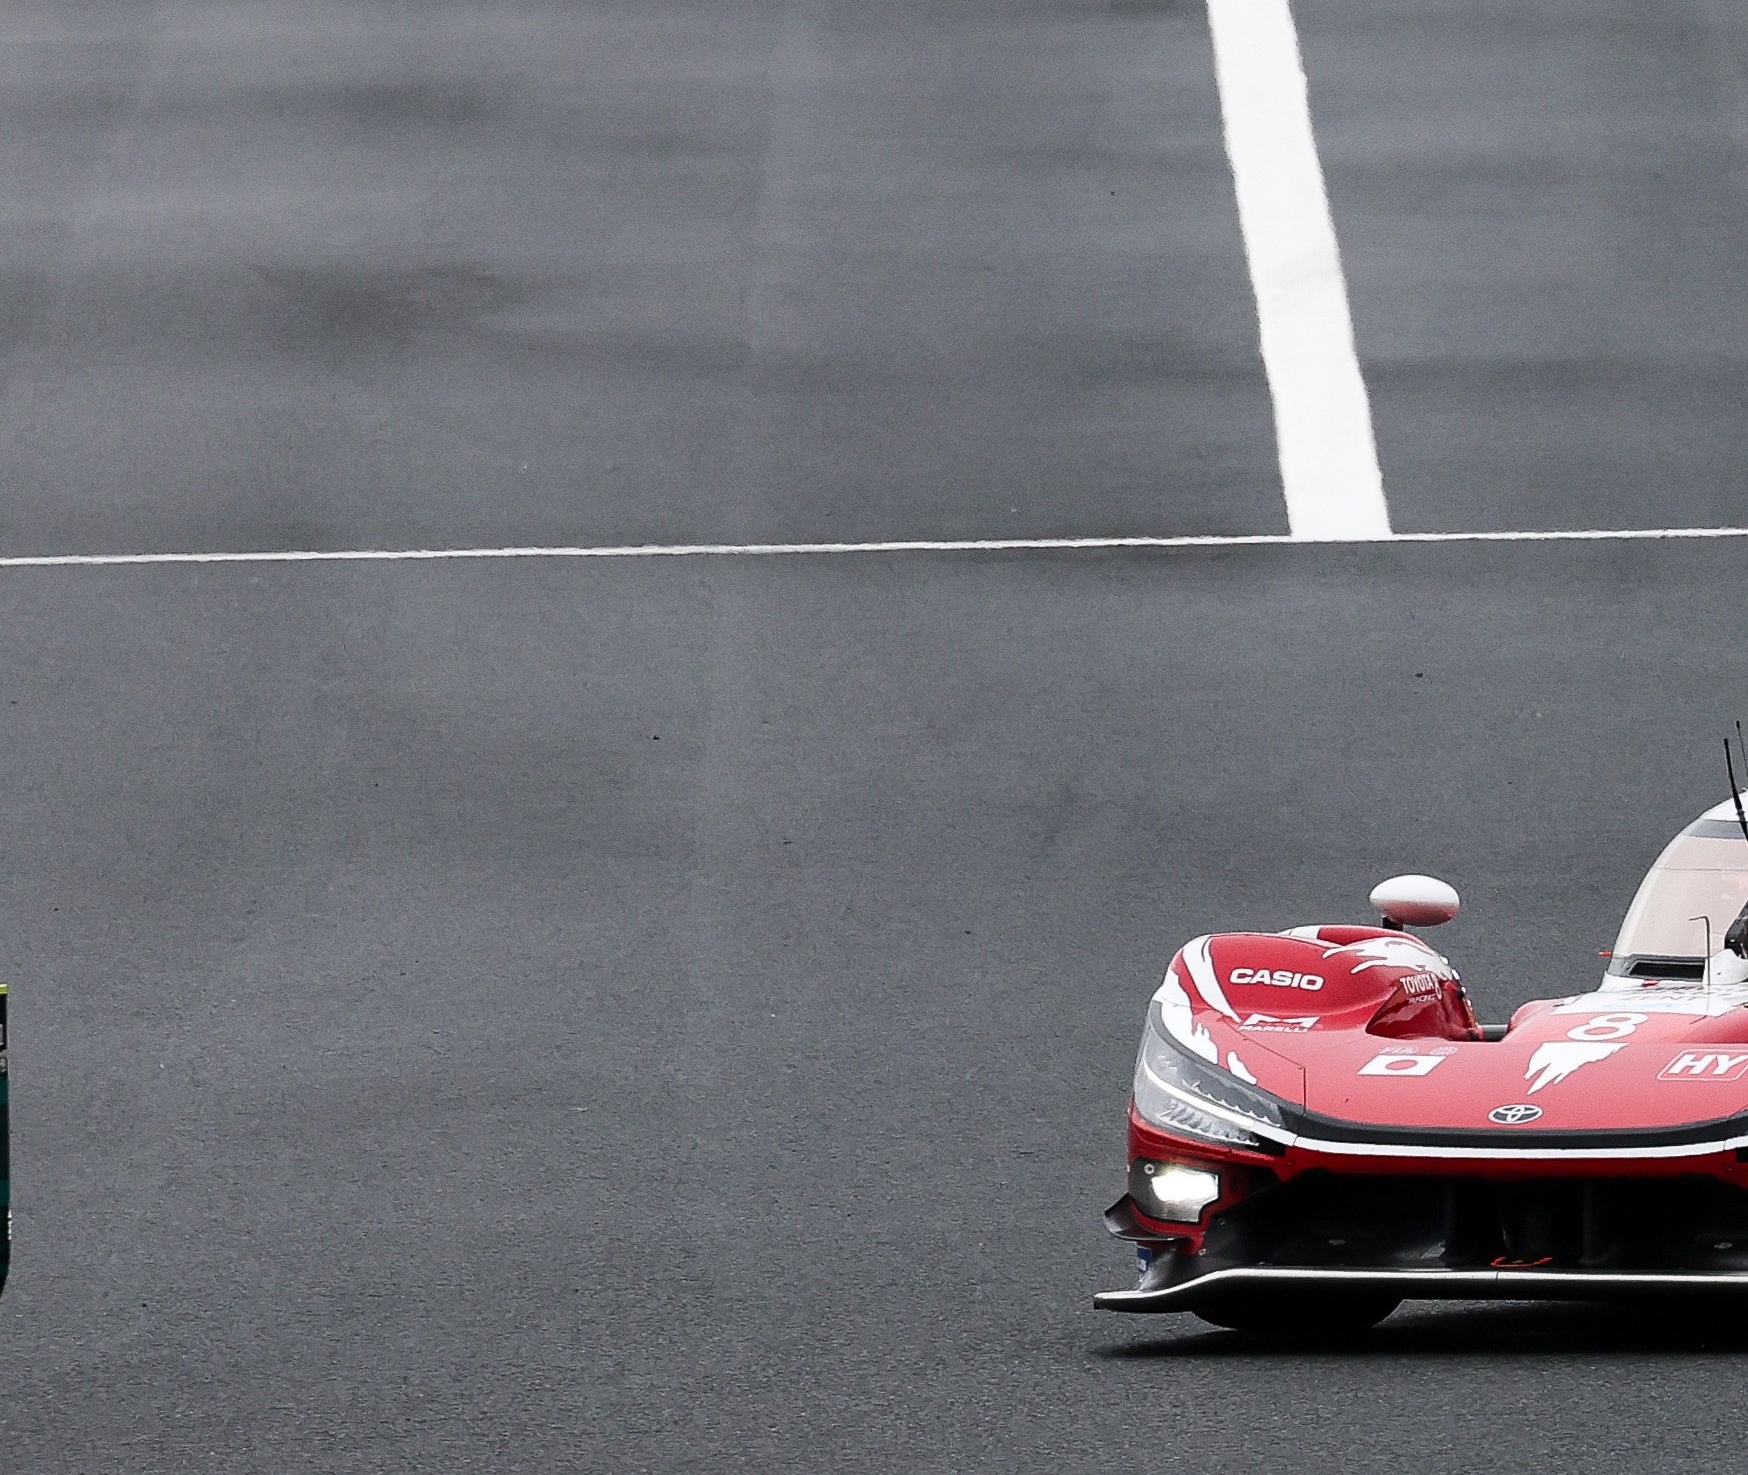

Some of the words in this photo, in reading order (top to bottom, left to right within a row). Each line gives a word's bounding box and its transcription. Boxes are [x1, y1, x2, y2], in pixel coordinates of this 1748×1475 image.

[1229, 968, 1325, 991] CASIO
[1400, 974, 1434, 995] TOYOTA
[1566, 1012, 1650, 1041] 8
